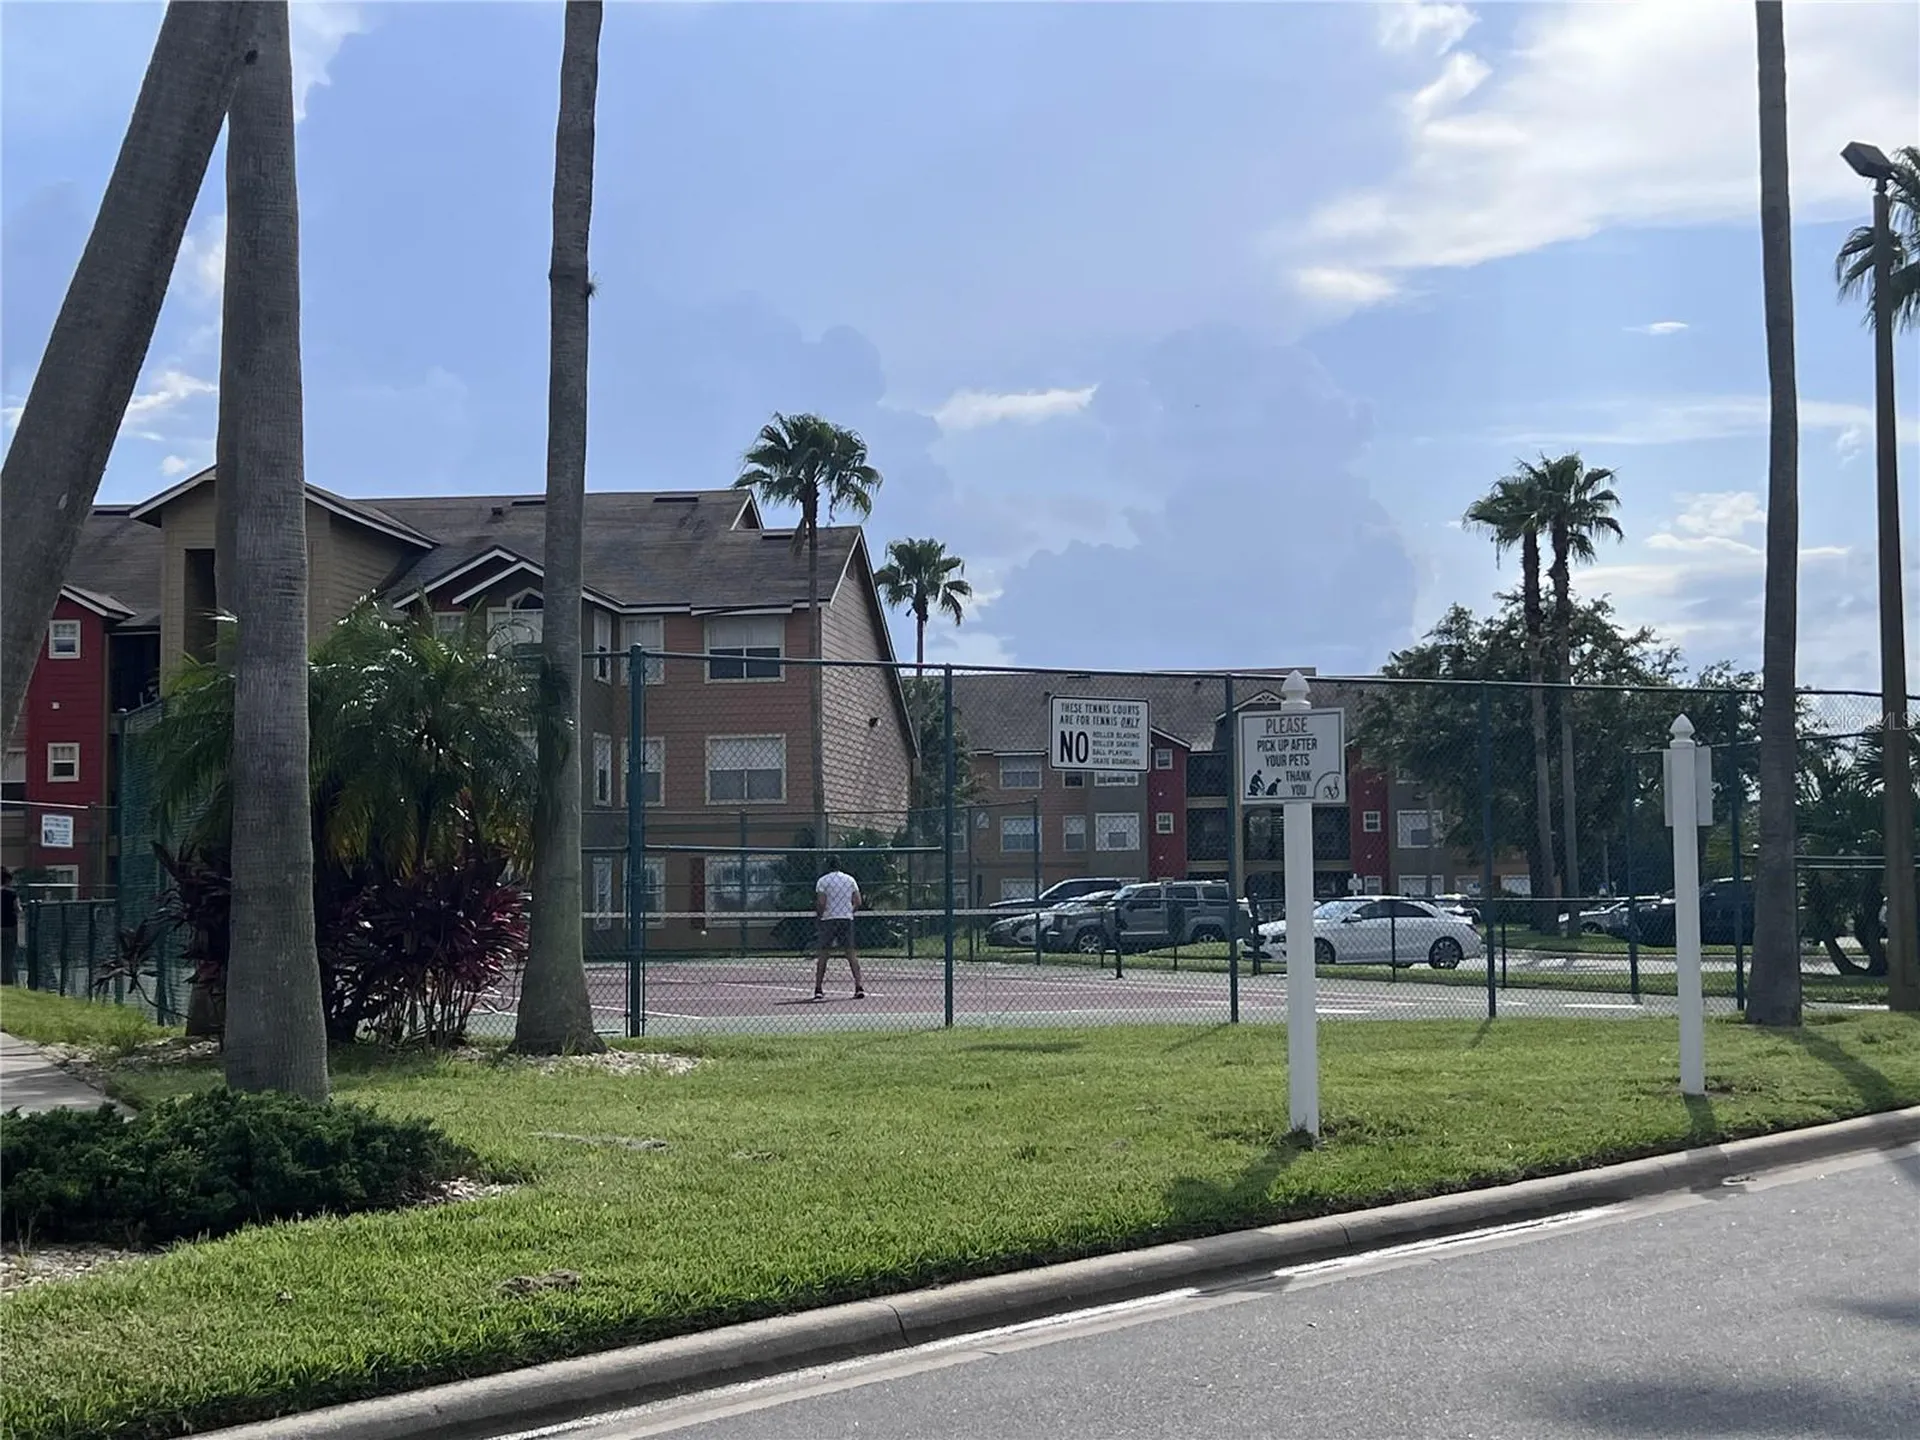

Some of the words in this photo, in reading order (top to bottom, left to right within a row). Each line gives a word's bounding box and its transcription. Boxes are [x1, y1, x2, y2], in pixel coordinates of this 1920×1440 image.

[1061, 703, 1082, 713] THESE
[1085, 704, 1110, 714] TENNIS
[1112, 705, 1139, 716] COURTS
[1060, 715, 1074, 725] ARE
[1076, 715, 1090, 725] FOR
[1093, 716, 1117, 726] TENNIS
[1120, 717, 1140, 728] ONLY
[1266, 717, 1308, 734] PLEASE
[1060, 731, 1088, 764] NO
[1257, 740, 1276, 752] PICK
[1278, 740, 1289, 751] UP
[1291, 738, 1317, 750] AFTER
[1265, 754, 1287, 767] YOUR
[1289, 753, 1310, 766] PETS
[1286, 770, 1312, 782] THANK
[1291, 784, 1307, 796] YOU
